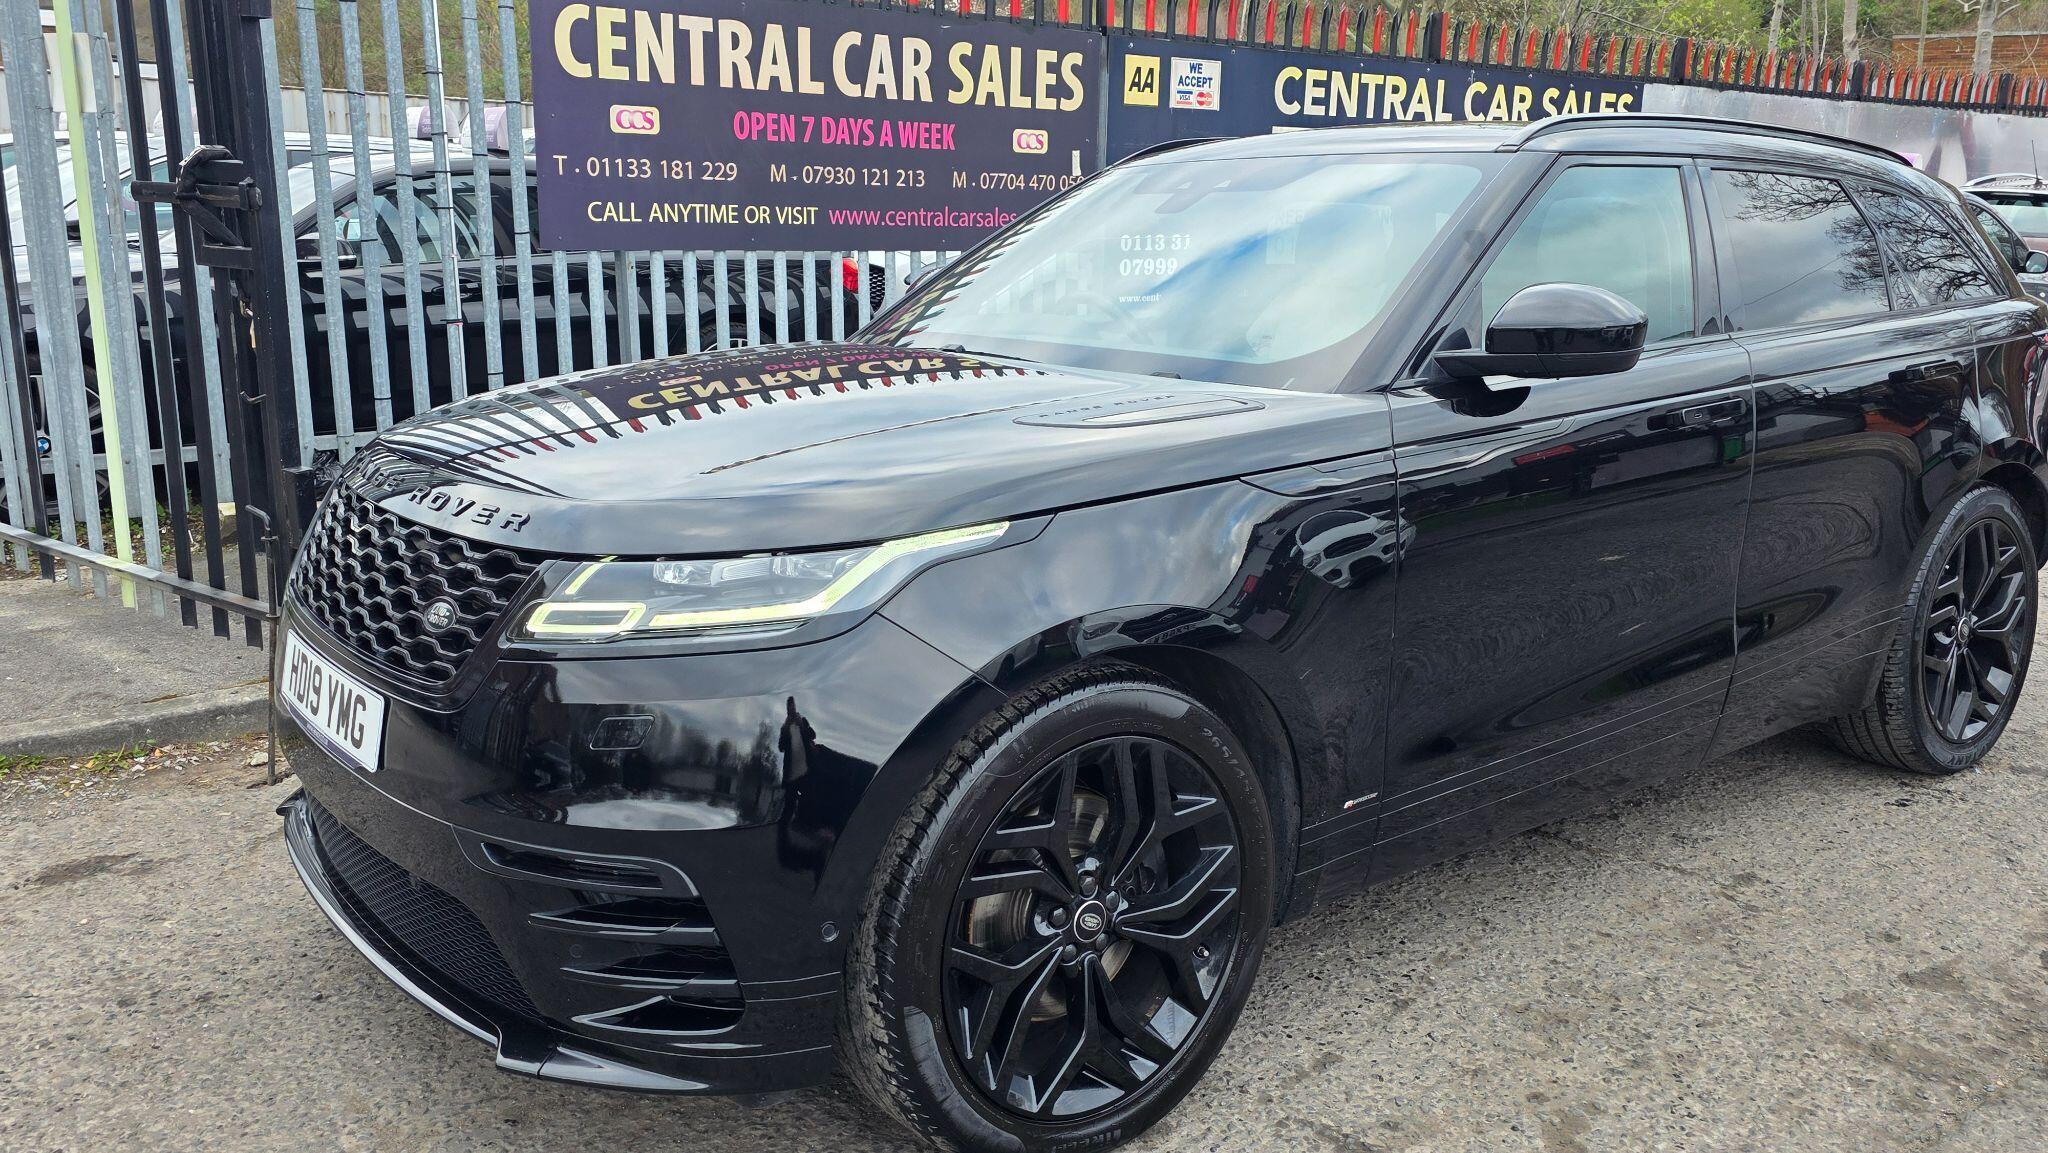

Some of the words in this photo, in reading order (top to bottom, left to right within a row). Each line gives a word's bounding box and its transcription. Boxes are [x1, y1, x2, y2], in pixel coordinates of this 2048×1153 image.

[554, 4, 824, 94] CENTRAL
[832, 31, 933, 102] CAR
[948, 41, 1084, 111] SALES
[1189, 62, 1203, 75] WE
[1128, 66, 1155, 94] AA
[1177, 75, 1213, 89] ACCEPT
[1274, 66, 1453, 122] CENTRAL
[1465, 81, 1532, 122] CAR
[615, 109, 655, 131] CCS
[733, 110, 796, 142] OPEN
[801, 116, 815, 143] 7
[821, 117, 875, 146] DAYS
[879, 120, 894, 147] A
[898, 121, 956, 150] WEEK
[1016, 132, 1044, 150] CCS
[586, 156, 652, 179] 01133
[660, 160, 693, 180] 181
[702, 162, 738, 181] 229
[802, 165, 856, 185] 07930
[862, 168, 889, 186] 121
[896, 169, 926, 187] 213
[980, 172, 1025, 190] 07704
[1029, 174, 1056, 191] 470
[587, 201, 642, 222] CALL
[649, 202, 739, 224] ANYTIME
[744, 205, 771, 224] OR
[776, 206, 819, 225] VISIT
[1120, 234, 1166, 251] 0113
[1119, 257, 1178, 277] 07999
[408, 484, 531, 533] ROVER
[289, 644, 322, 717] HD19
[327, 674, 367, 750] YMG
